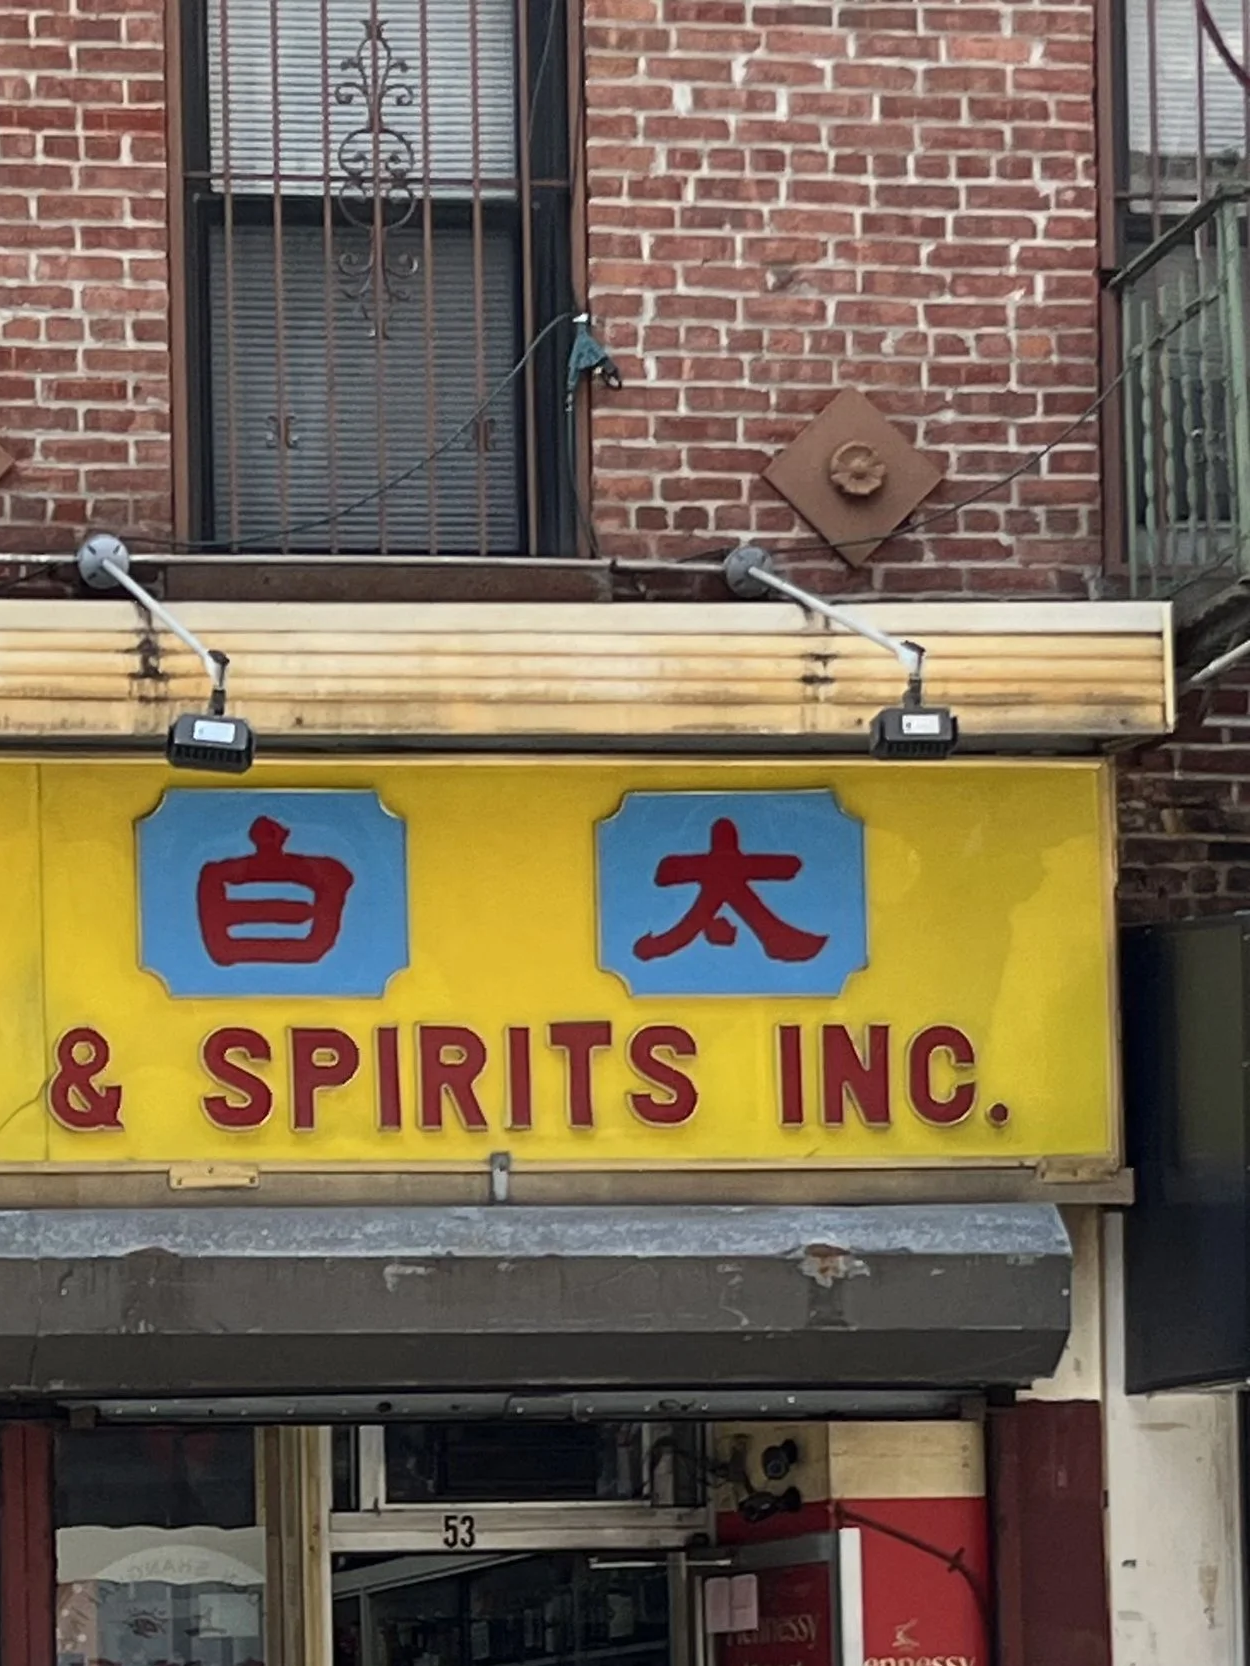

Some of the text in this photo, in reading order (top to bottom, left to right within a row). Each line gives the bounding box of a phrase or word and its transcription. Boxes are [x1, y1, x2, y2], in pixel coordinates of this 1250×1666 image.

[49, 1025, 123, 1132] &
[200, 1019, 698, 1132] SPIRITS
[780, 1022, 1011, 1128] INC.
[443, 1514, 476, 1549] 53
